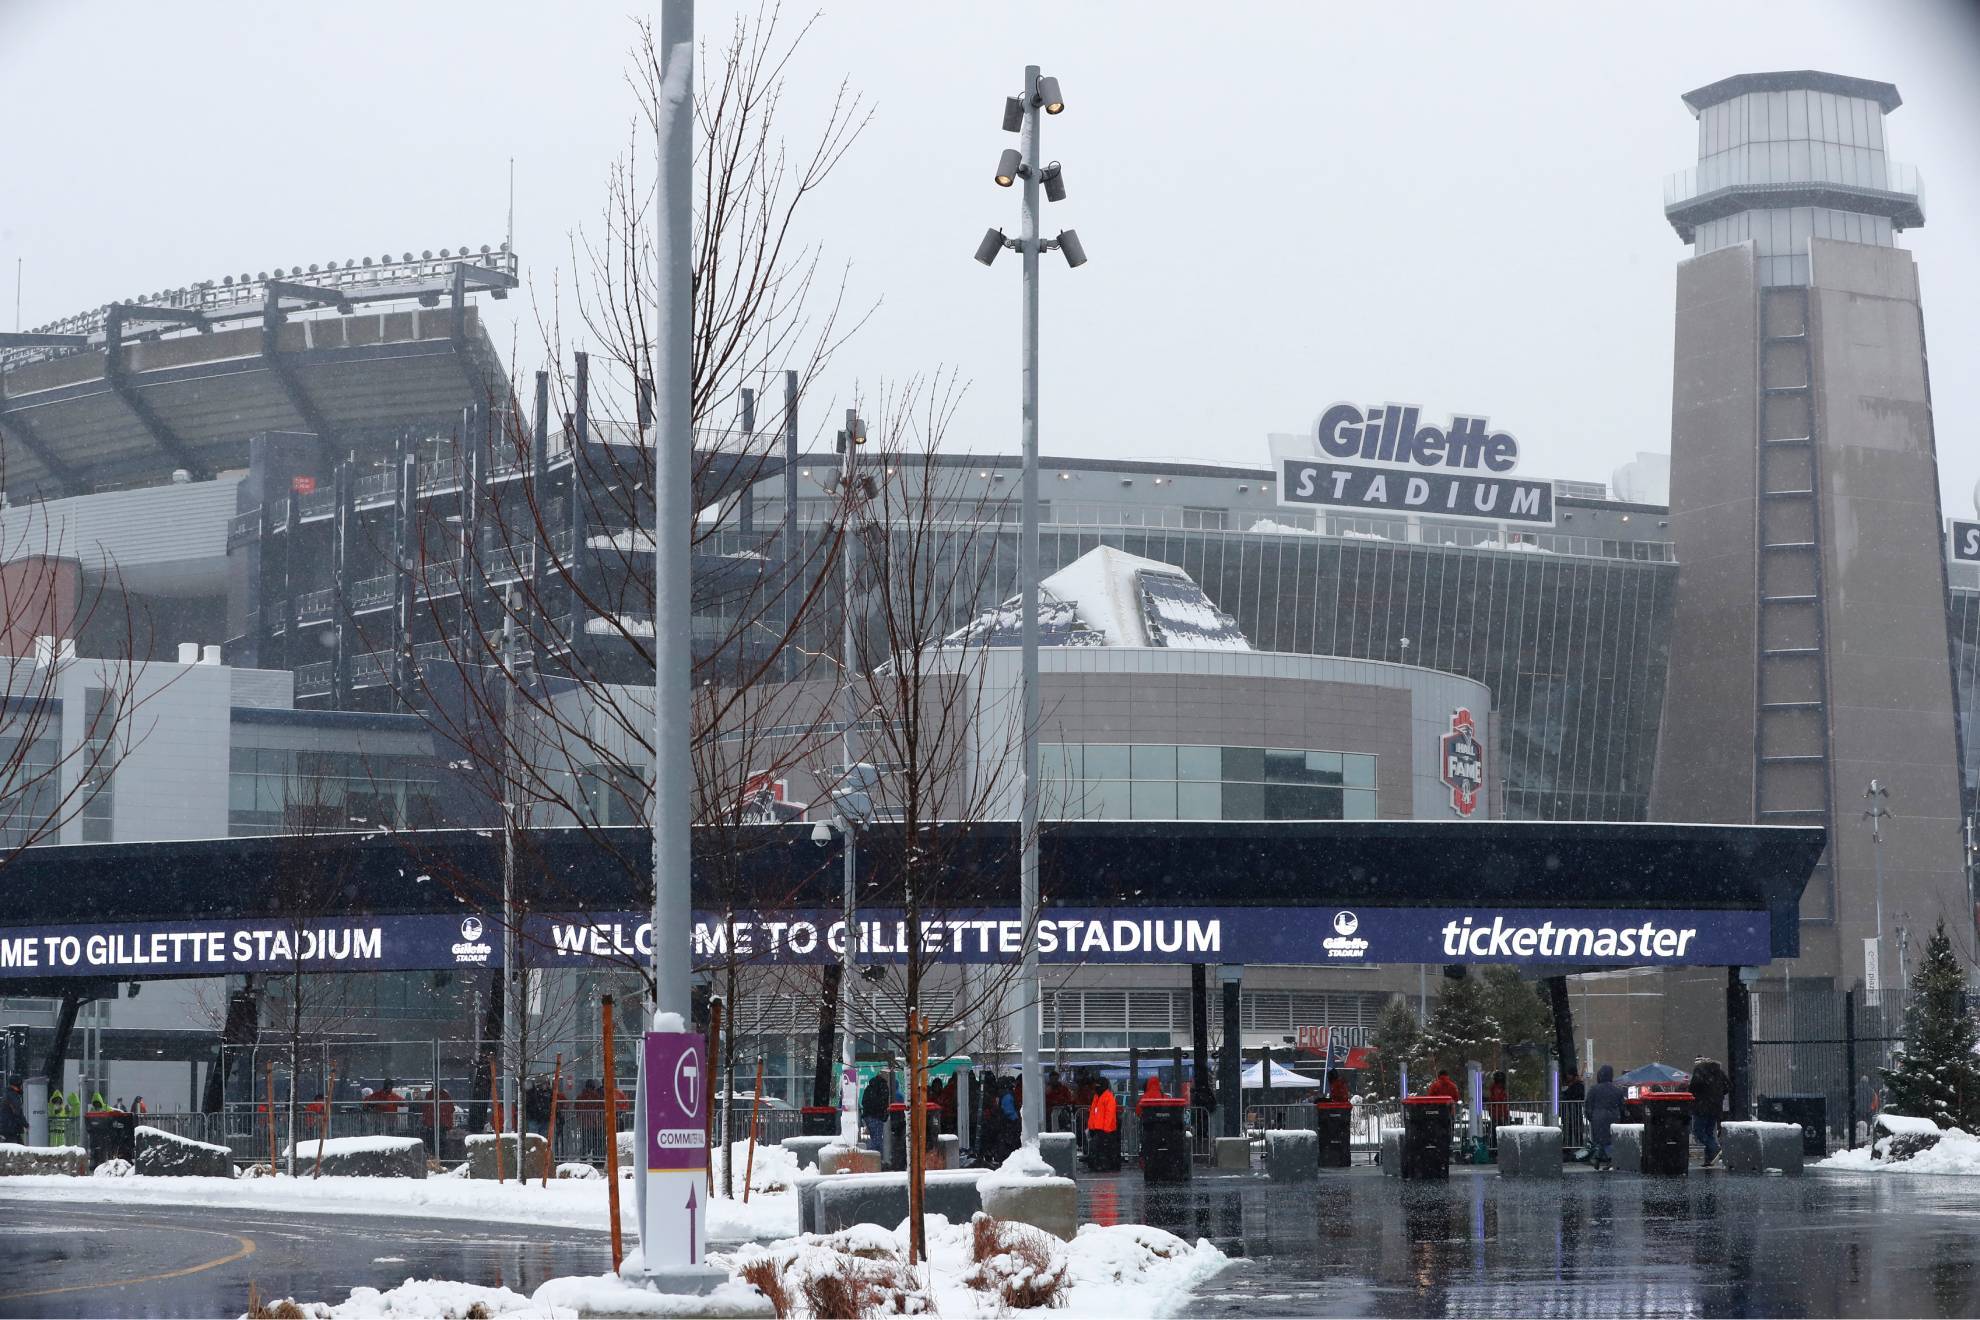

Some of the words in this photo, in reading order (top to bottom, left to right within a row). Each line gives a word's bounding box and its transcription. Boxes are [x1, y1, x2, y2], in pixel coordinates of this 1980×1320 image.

[1318, 404, 1518, 473] Gillette
[1296, 467, 1541, 516] STADIUM
[1448, 755, 1482, 784] FAME
[1, 936, 38, 967] ME
[44, 935, 81, 966] TO
[86, 931, 226, 965] GILLETTE
[232, 927, 382, 962] STADIUM
[451, 942, 492, 955] Gillette
[551, 921, 753, 956] WELCME
[760, 920, 818, 954] TO
[1037, 918, 1221, 954] STADIUM
[1322, 936, 1369, 950] Gillette
[1327, 949, 1364, 958] STADIUM
[1441, 915, 1697, 958] ticketmaster
[455, 954, 488, 962] STADIUM
[682, 1066, 697, 1103] T
